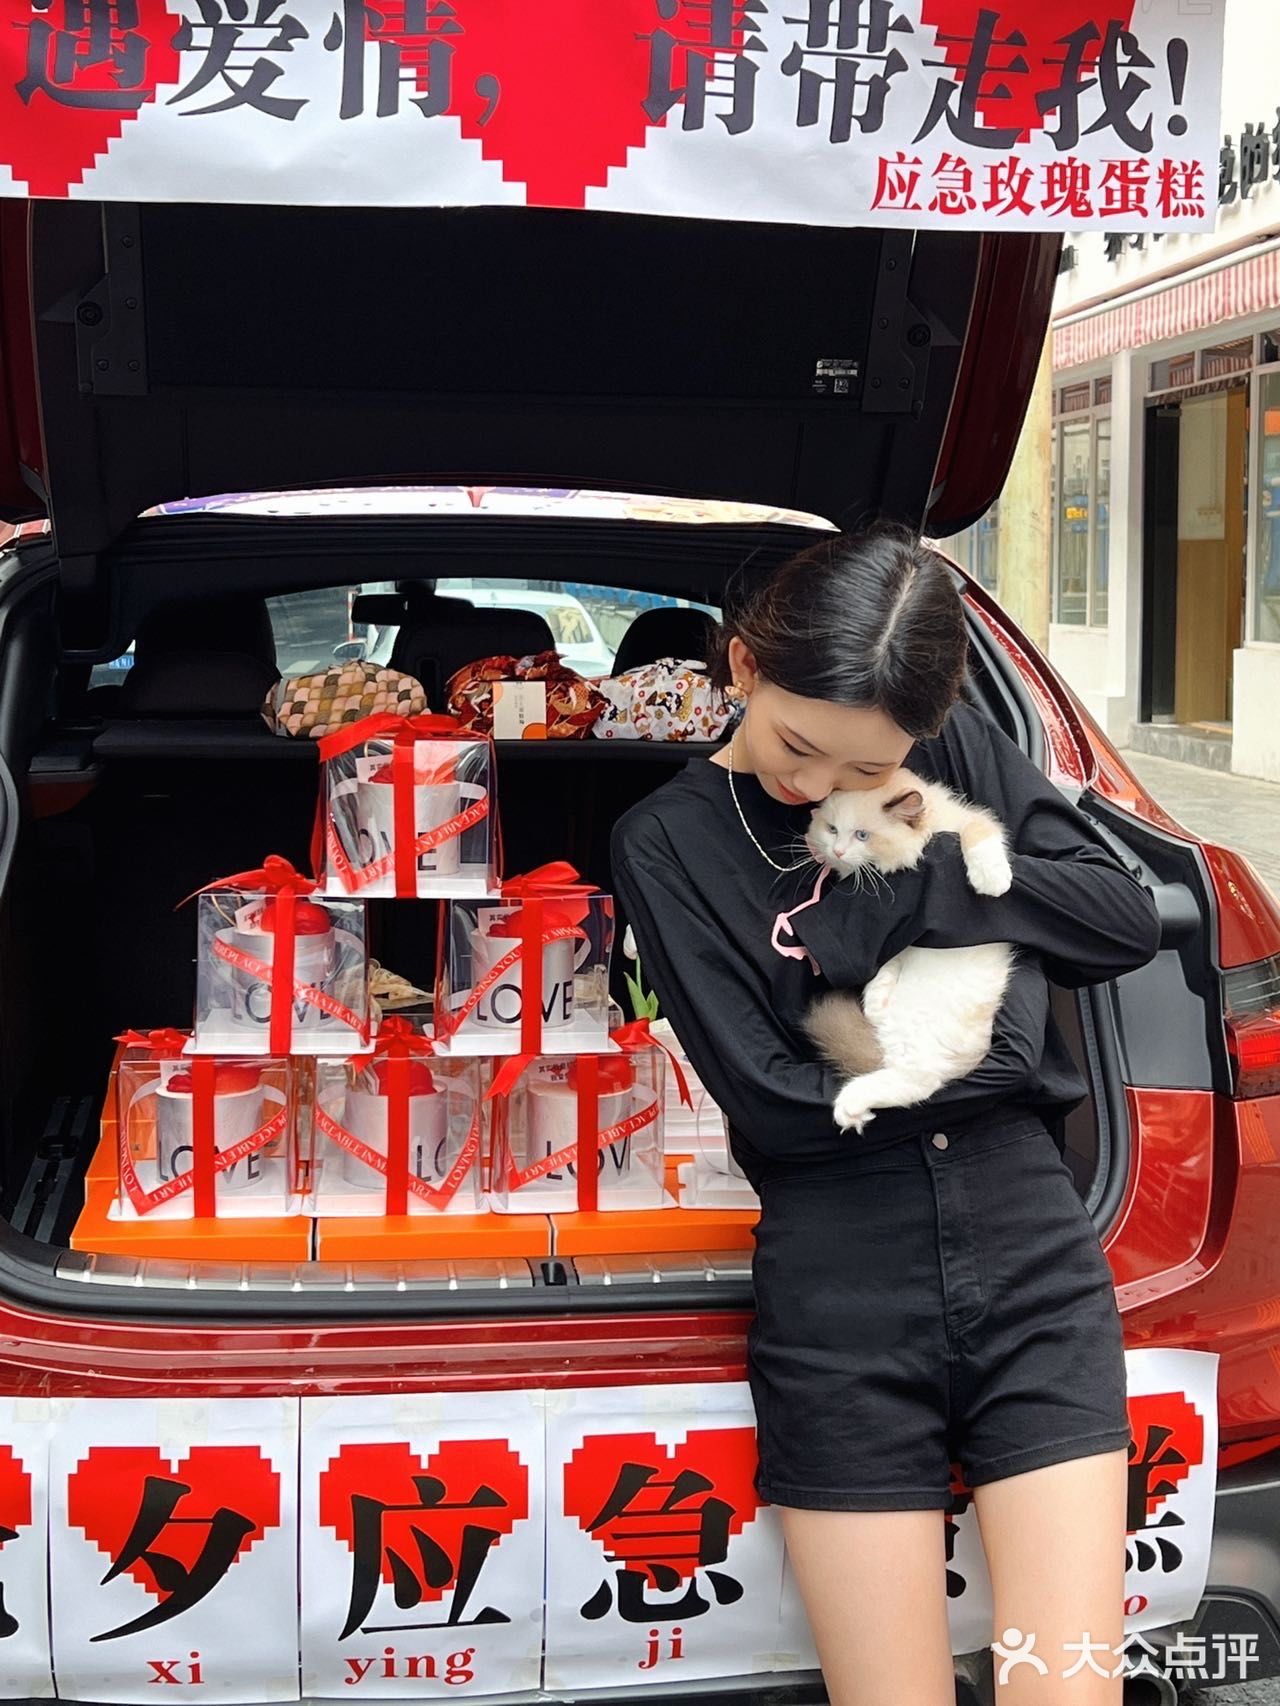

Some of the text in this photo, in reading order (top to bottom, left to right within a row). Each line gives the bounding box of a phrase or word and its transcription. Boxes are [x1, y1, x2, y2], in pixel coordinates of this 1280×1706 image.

[870, 152, 1205, 218] 应急玫瑰蛋糕
[476, 980, 573, 1023] LOVE
[147, 1627, 686, 1686] xi ying ji
